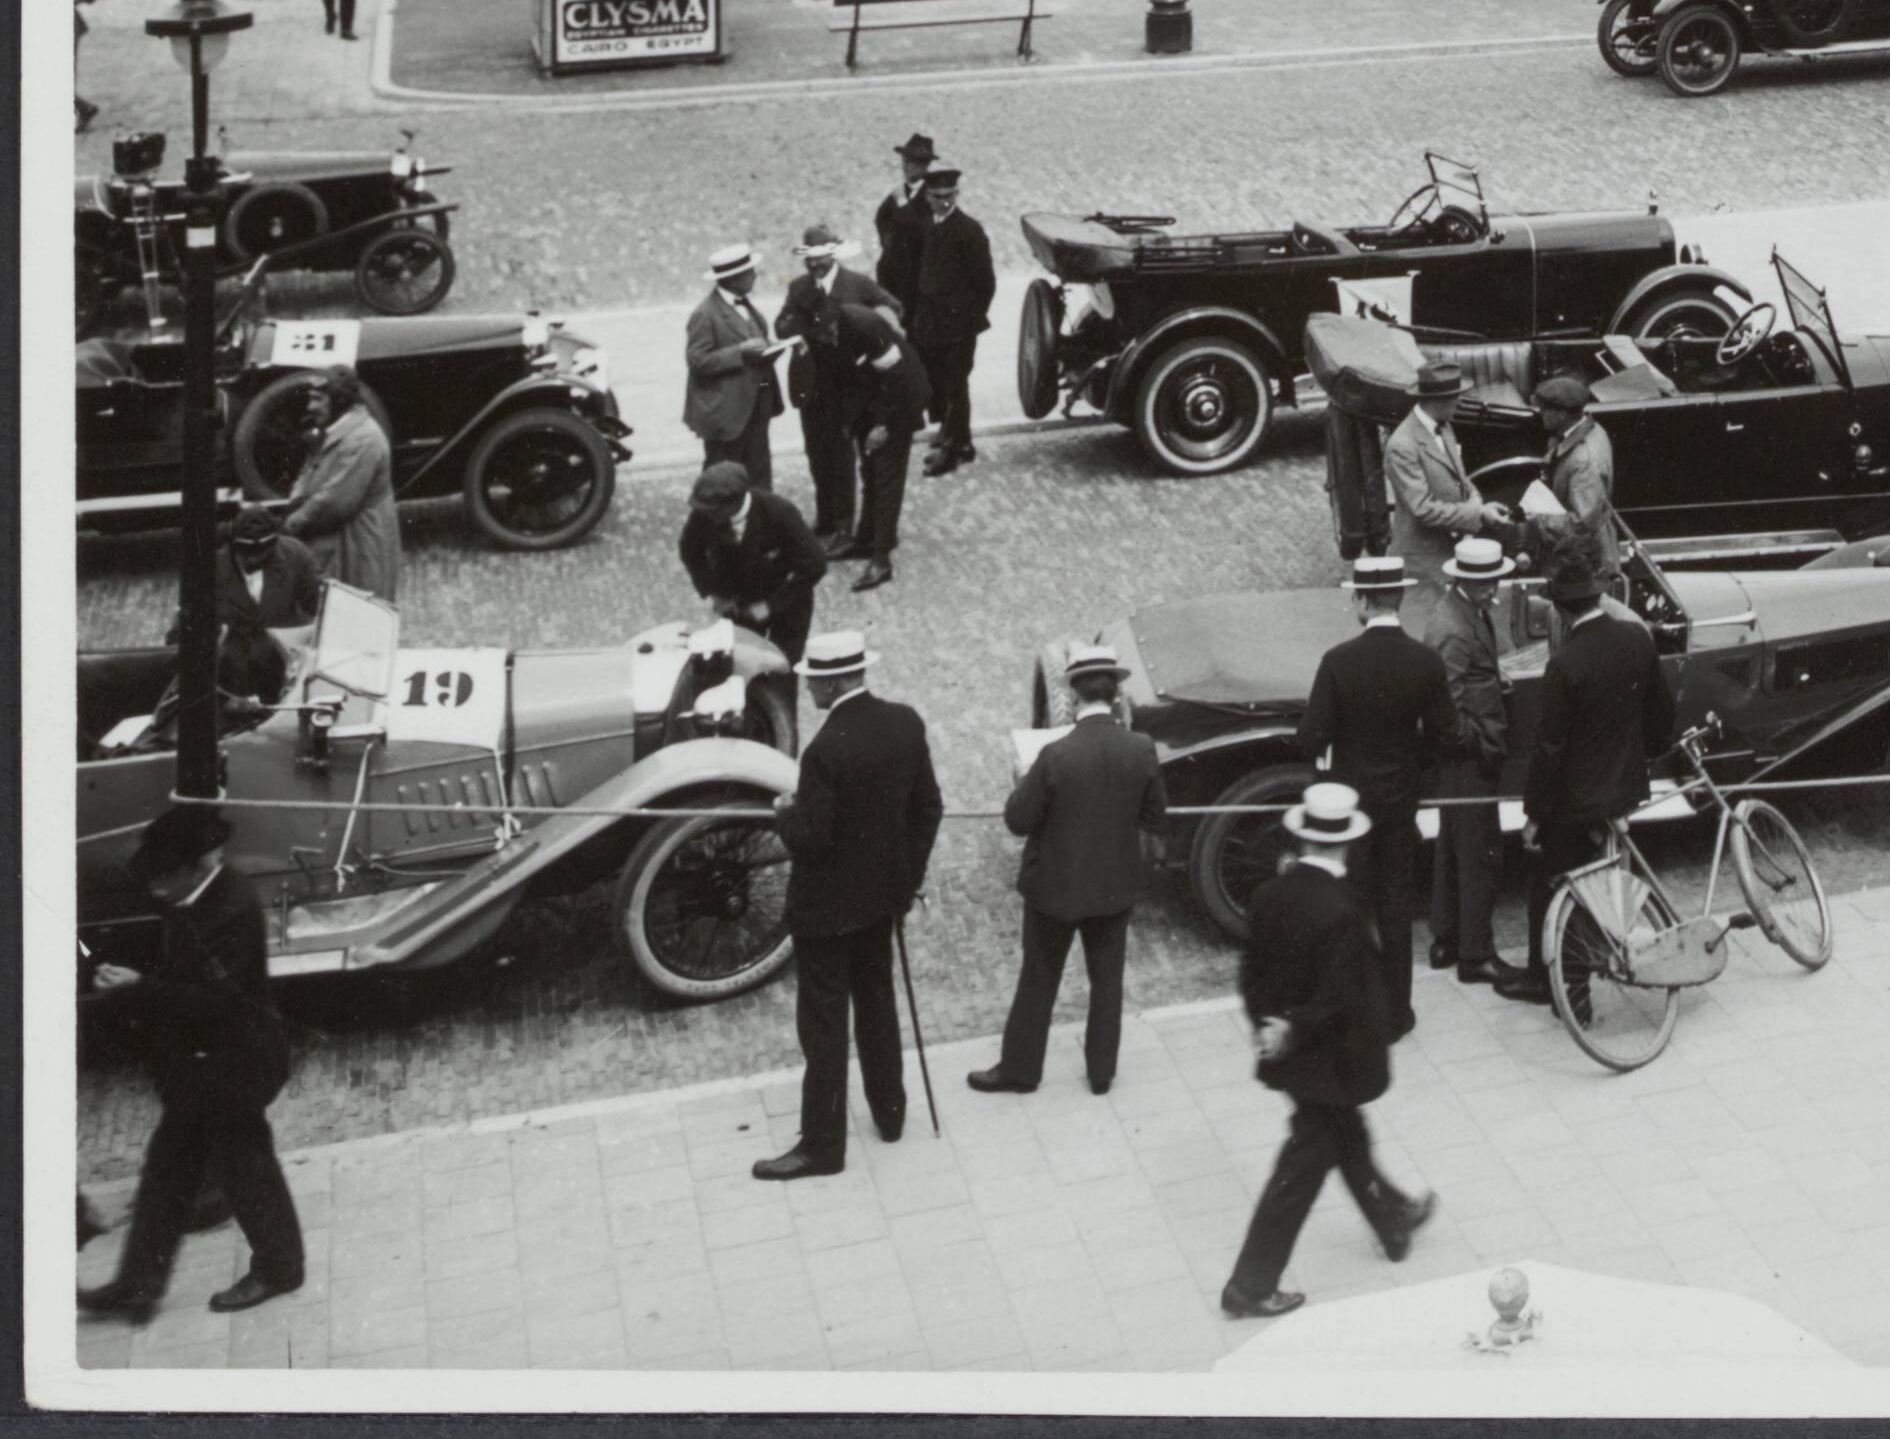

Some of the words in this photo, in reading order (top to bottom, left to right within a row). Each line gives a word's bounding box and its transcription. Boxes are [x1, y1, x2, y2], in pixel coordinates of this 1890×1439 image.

[566, 40, 629, 56] CAIRO
[646, 36, 704, 50] EGYPT
[402, 670, 474, 708] 19
